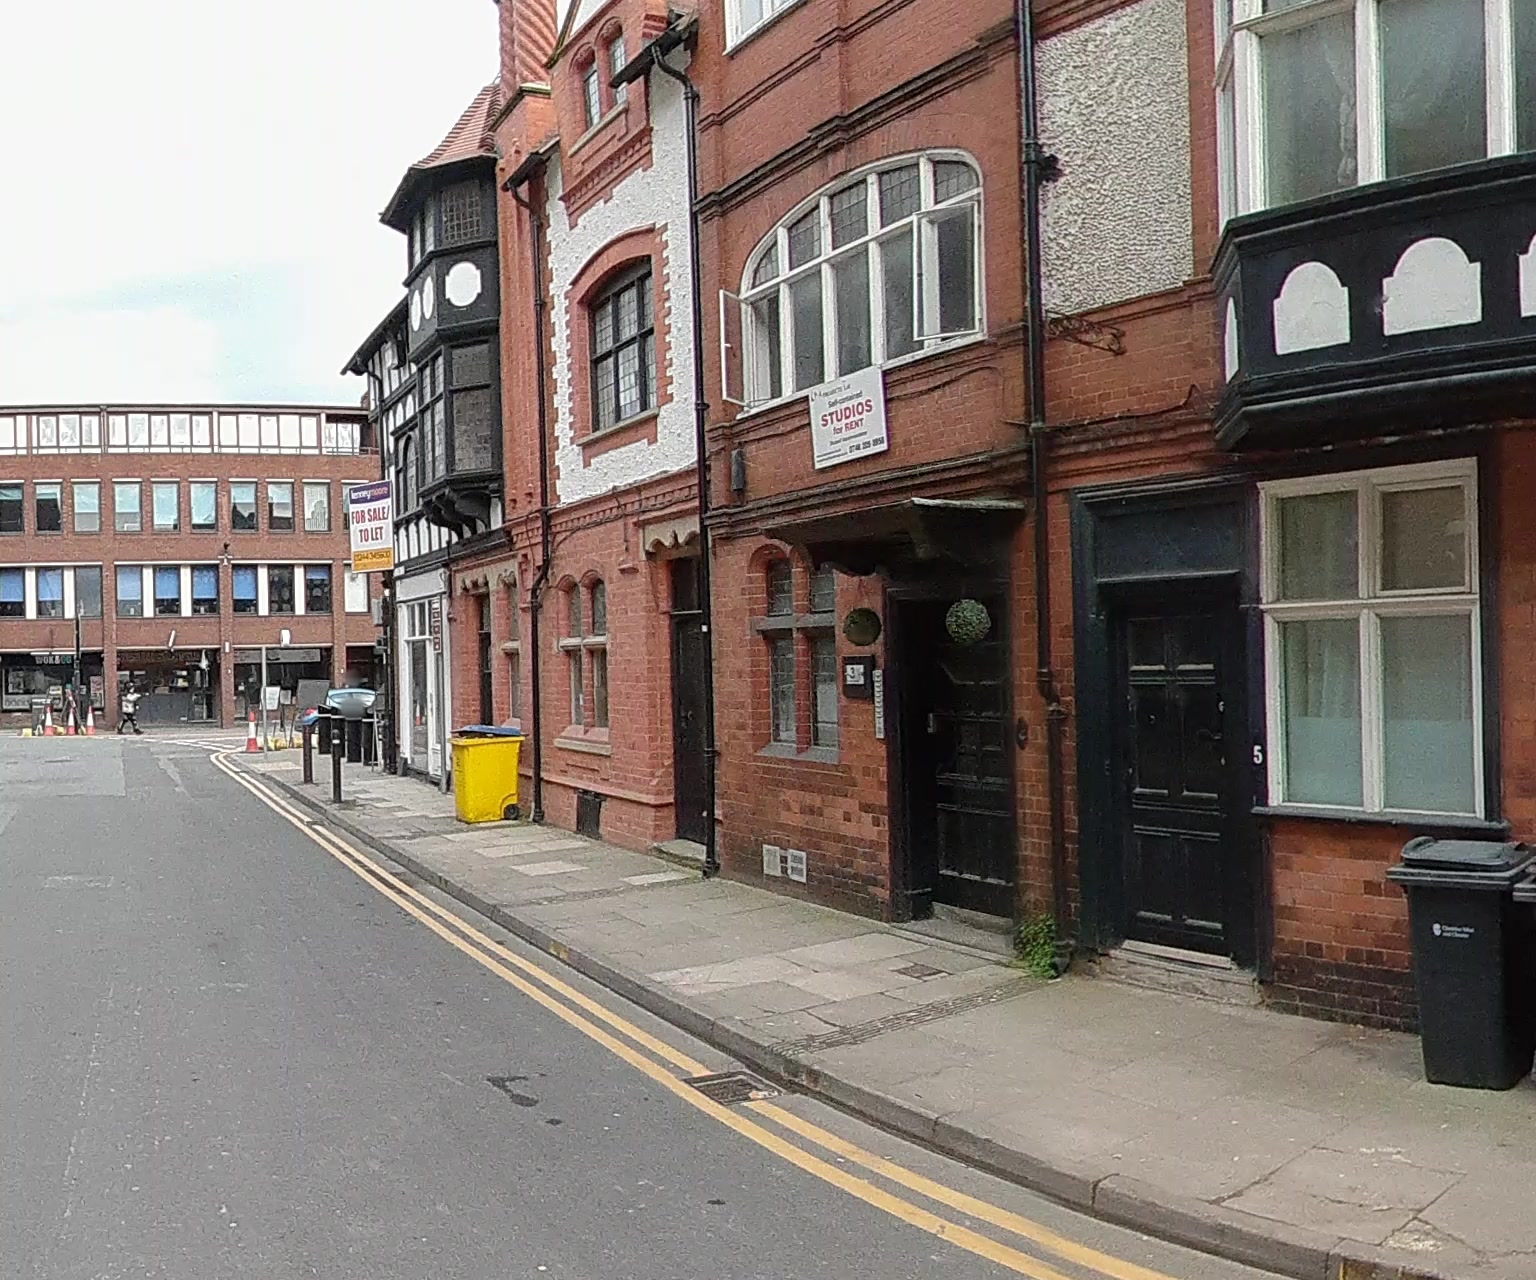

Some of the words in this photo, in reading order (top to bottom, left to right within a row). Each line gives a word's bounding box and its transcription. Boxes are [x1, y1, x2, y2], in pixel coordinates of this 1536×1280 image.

[821, 399, 873, 427] STUDIOS
[833, 426, 843, 435] for
[844, 418, 865, 432] RENT
[351, 510, 366, 525] FOR
[367, 505, 390, 522] SALE/
[358, 528, 369, 543] TO
[370, 526, 384, 541] LET
[1253, 744, 1263, 764] 5
